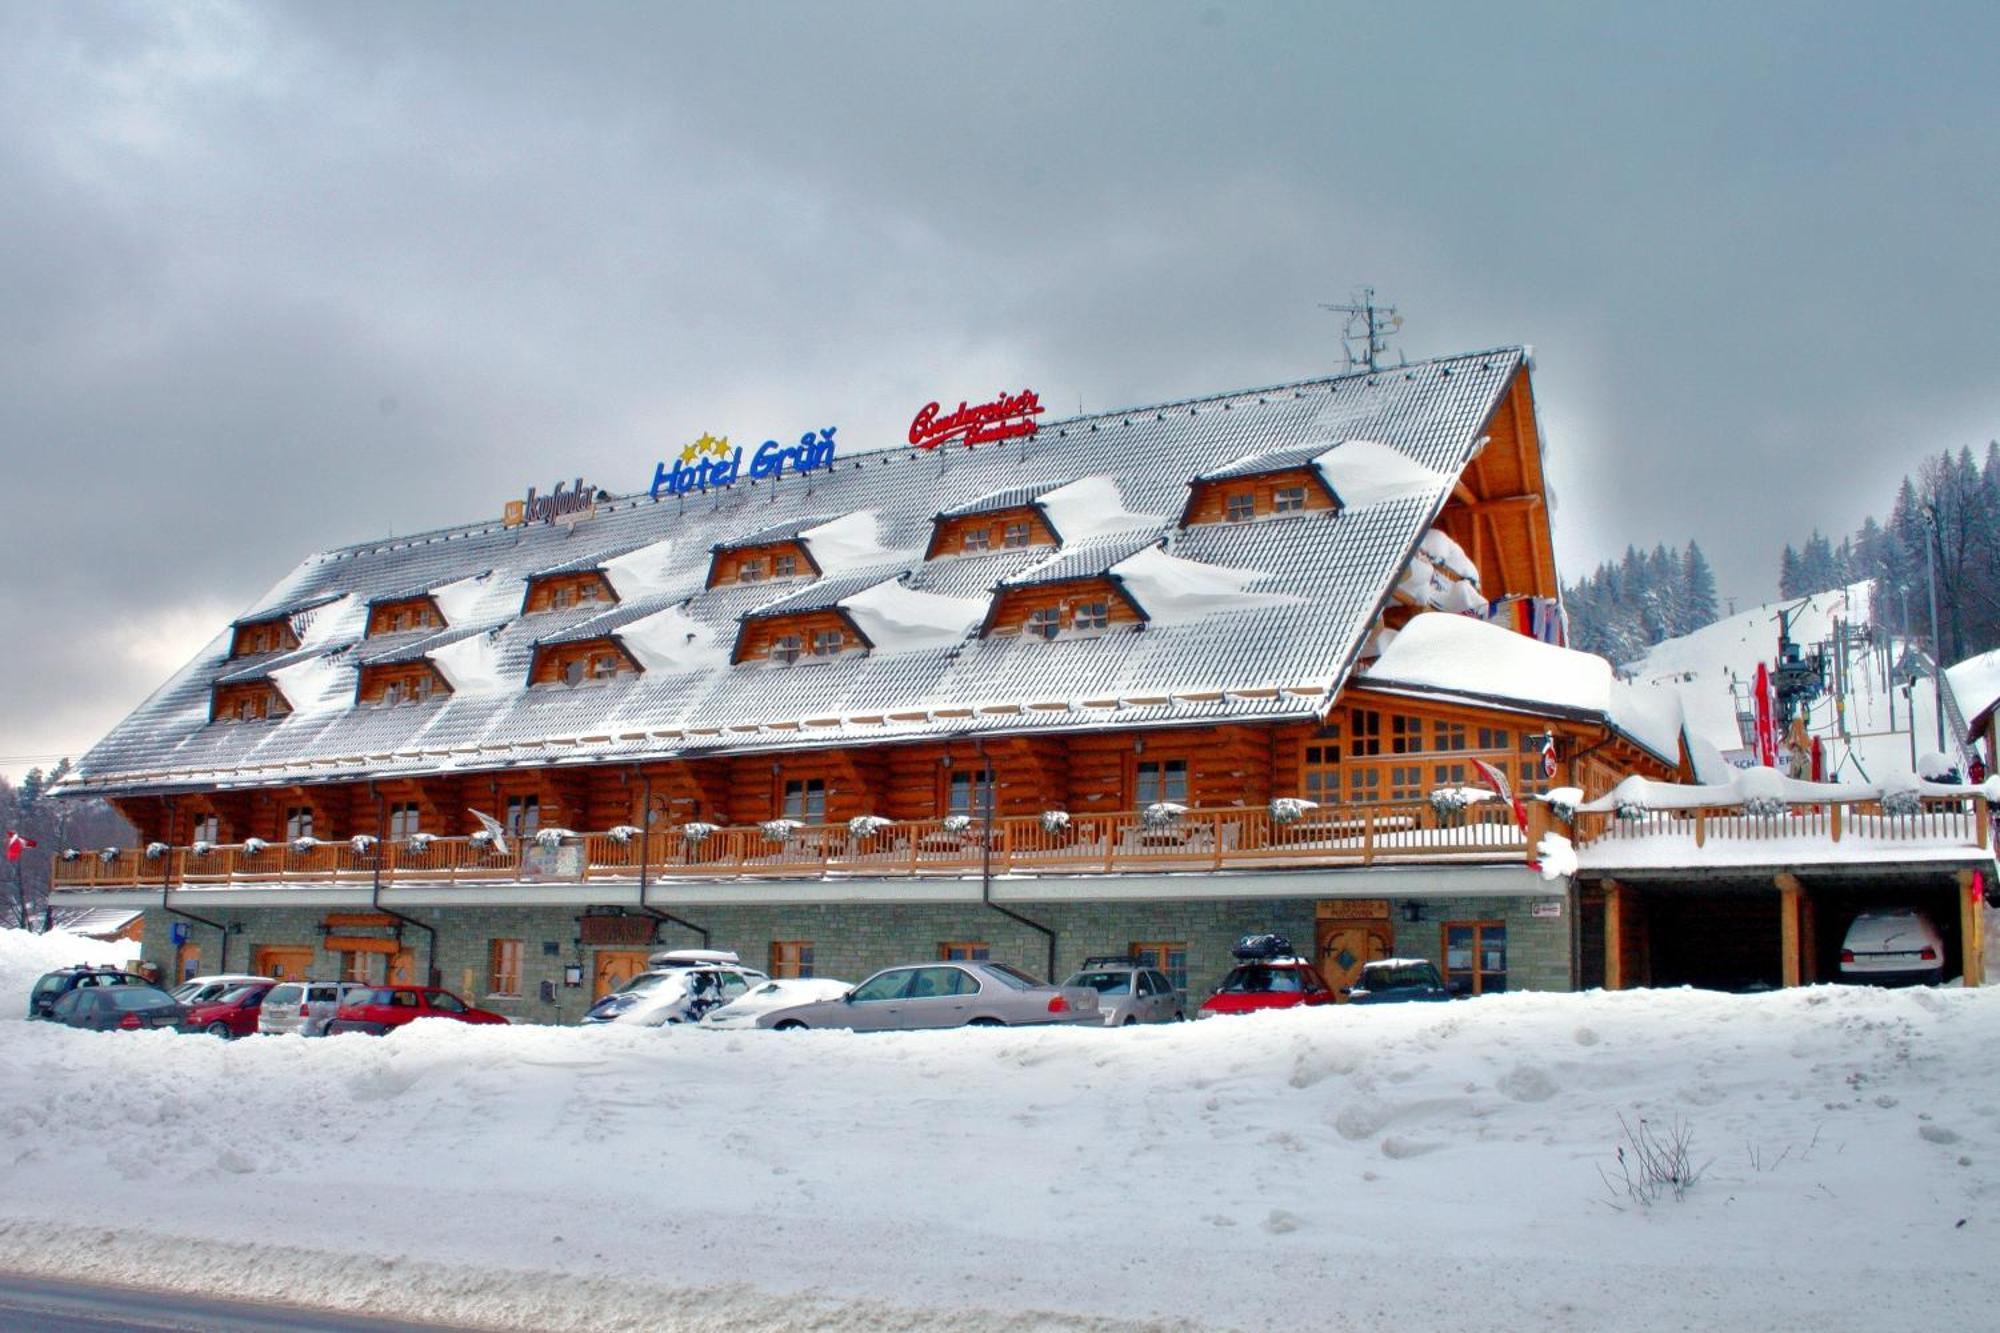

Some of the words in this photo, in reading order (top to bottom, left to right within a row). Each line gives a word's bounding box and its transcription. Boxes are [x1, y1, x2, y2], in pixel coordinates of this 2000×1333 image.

[909, 389, 1045, 447] Budweiser
[651, 447, 743, 498] Hotel
[750, 426, 837, 479] Grůň
[525, 478, 597, 527] kofola
